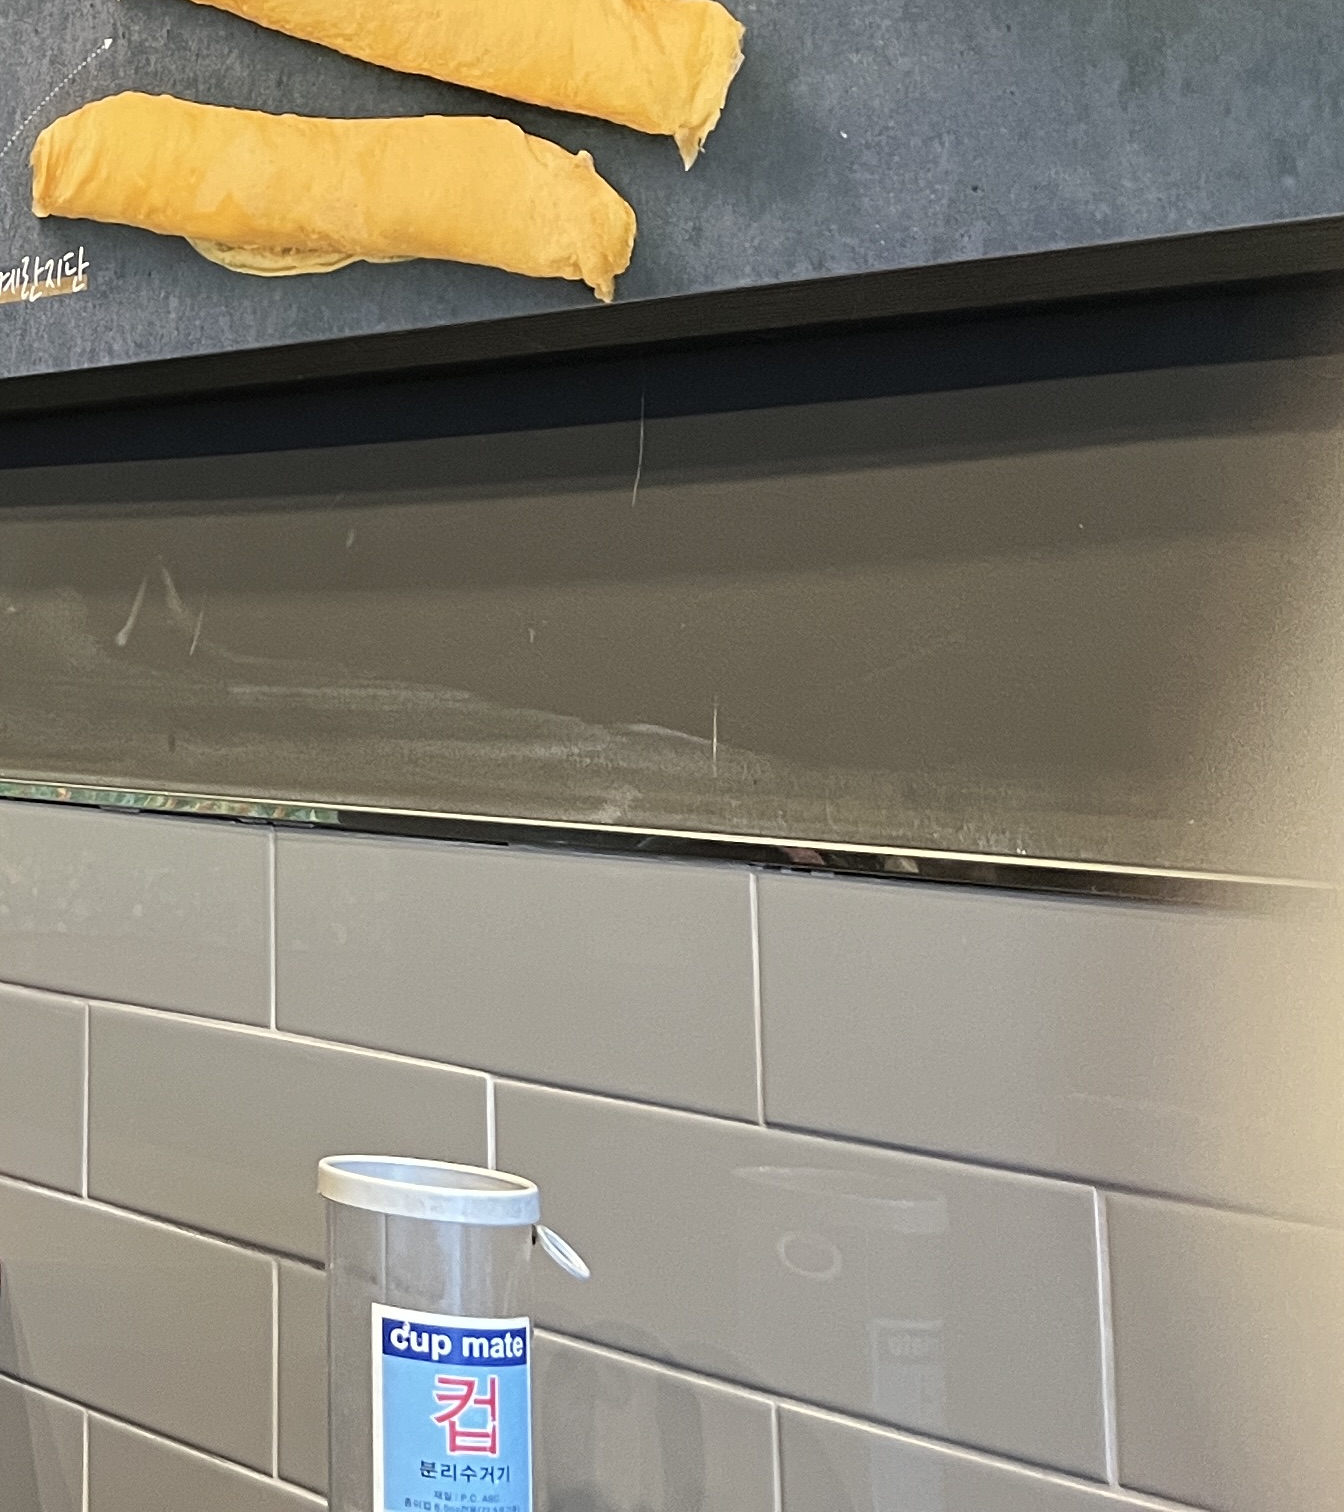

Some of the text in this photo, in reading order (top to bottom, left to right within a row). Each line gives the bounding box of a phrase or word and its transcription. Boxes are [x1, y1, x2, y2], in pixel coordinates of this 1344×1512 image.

[390, 1321, 524, 1361] cup mate
[433, 1376, 498, 1456] 컵
[420, 1460, 510, 1484] 분리수거기
